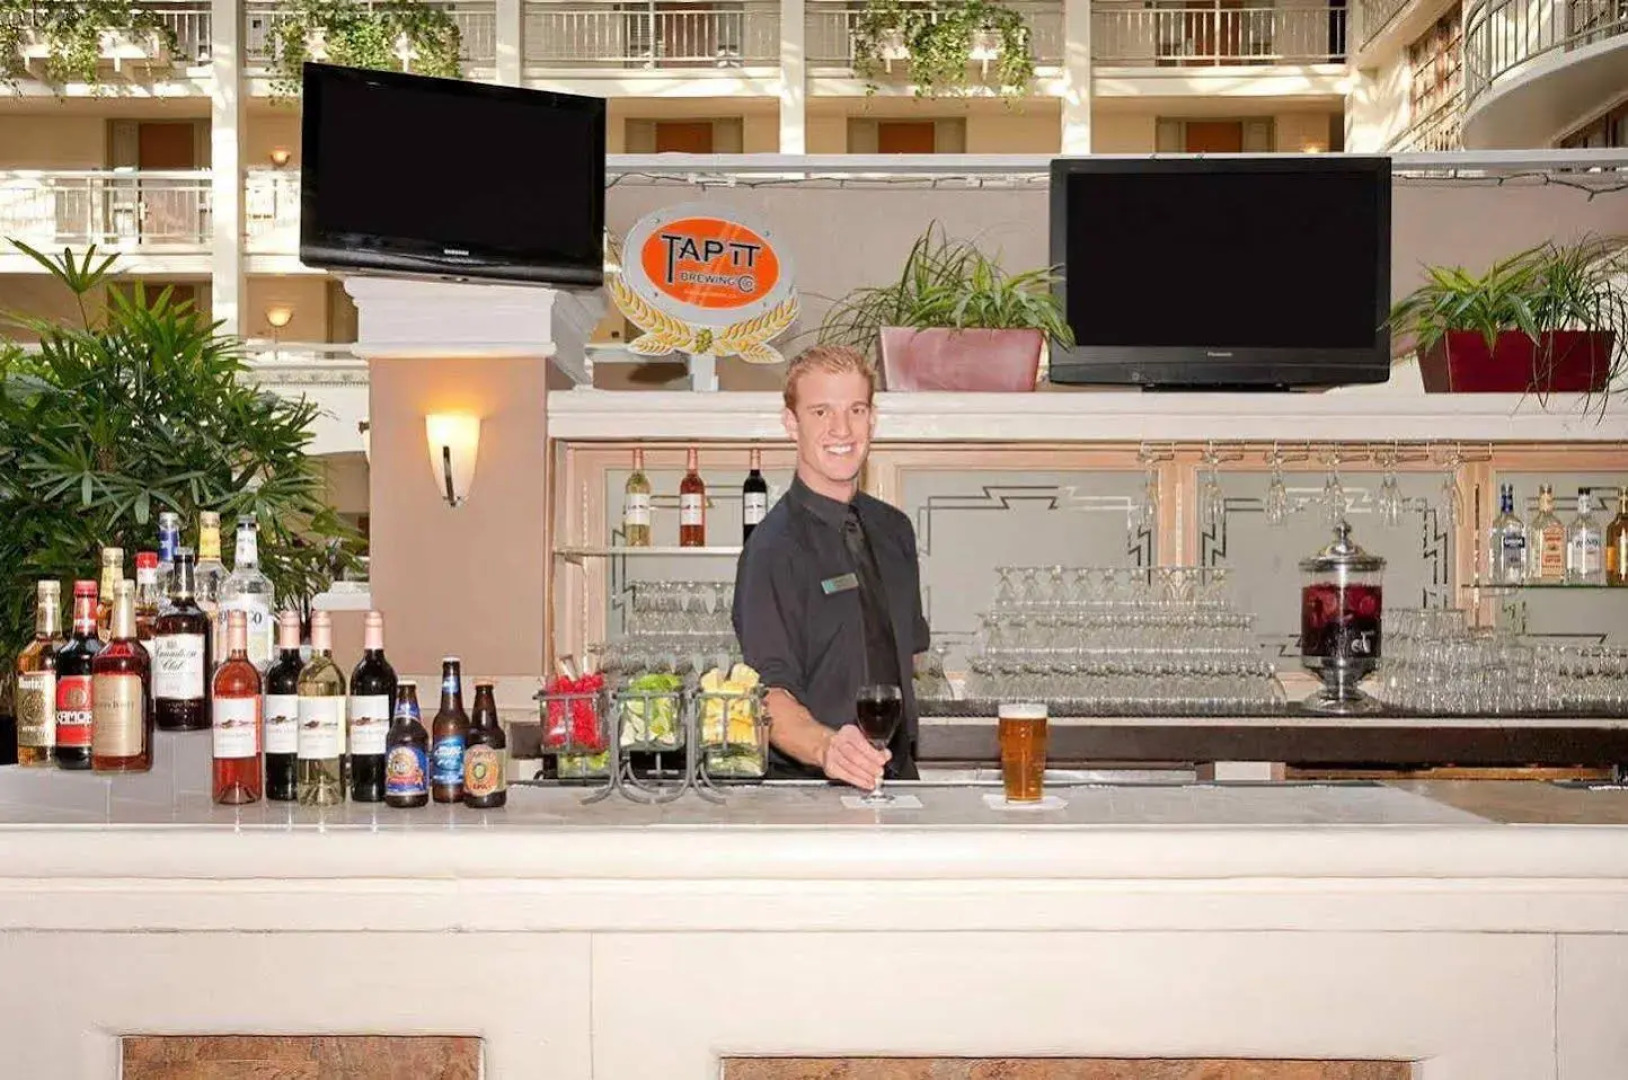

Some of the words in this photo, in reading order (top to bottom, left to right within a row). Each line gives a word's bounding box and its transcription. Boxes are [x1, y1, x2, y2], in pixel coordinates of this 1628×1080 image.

[661, 234, 724, 283] TAP
[729, 243, 761, 267] IT
[680, 272, 735, 286] BREWING
